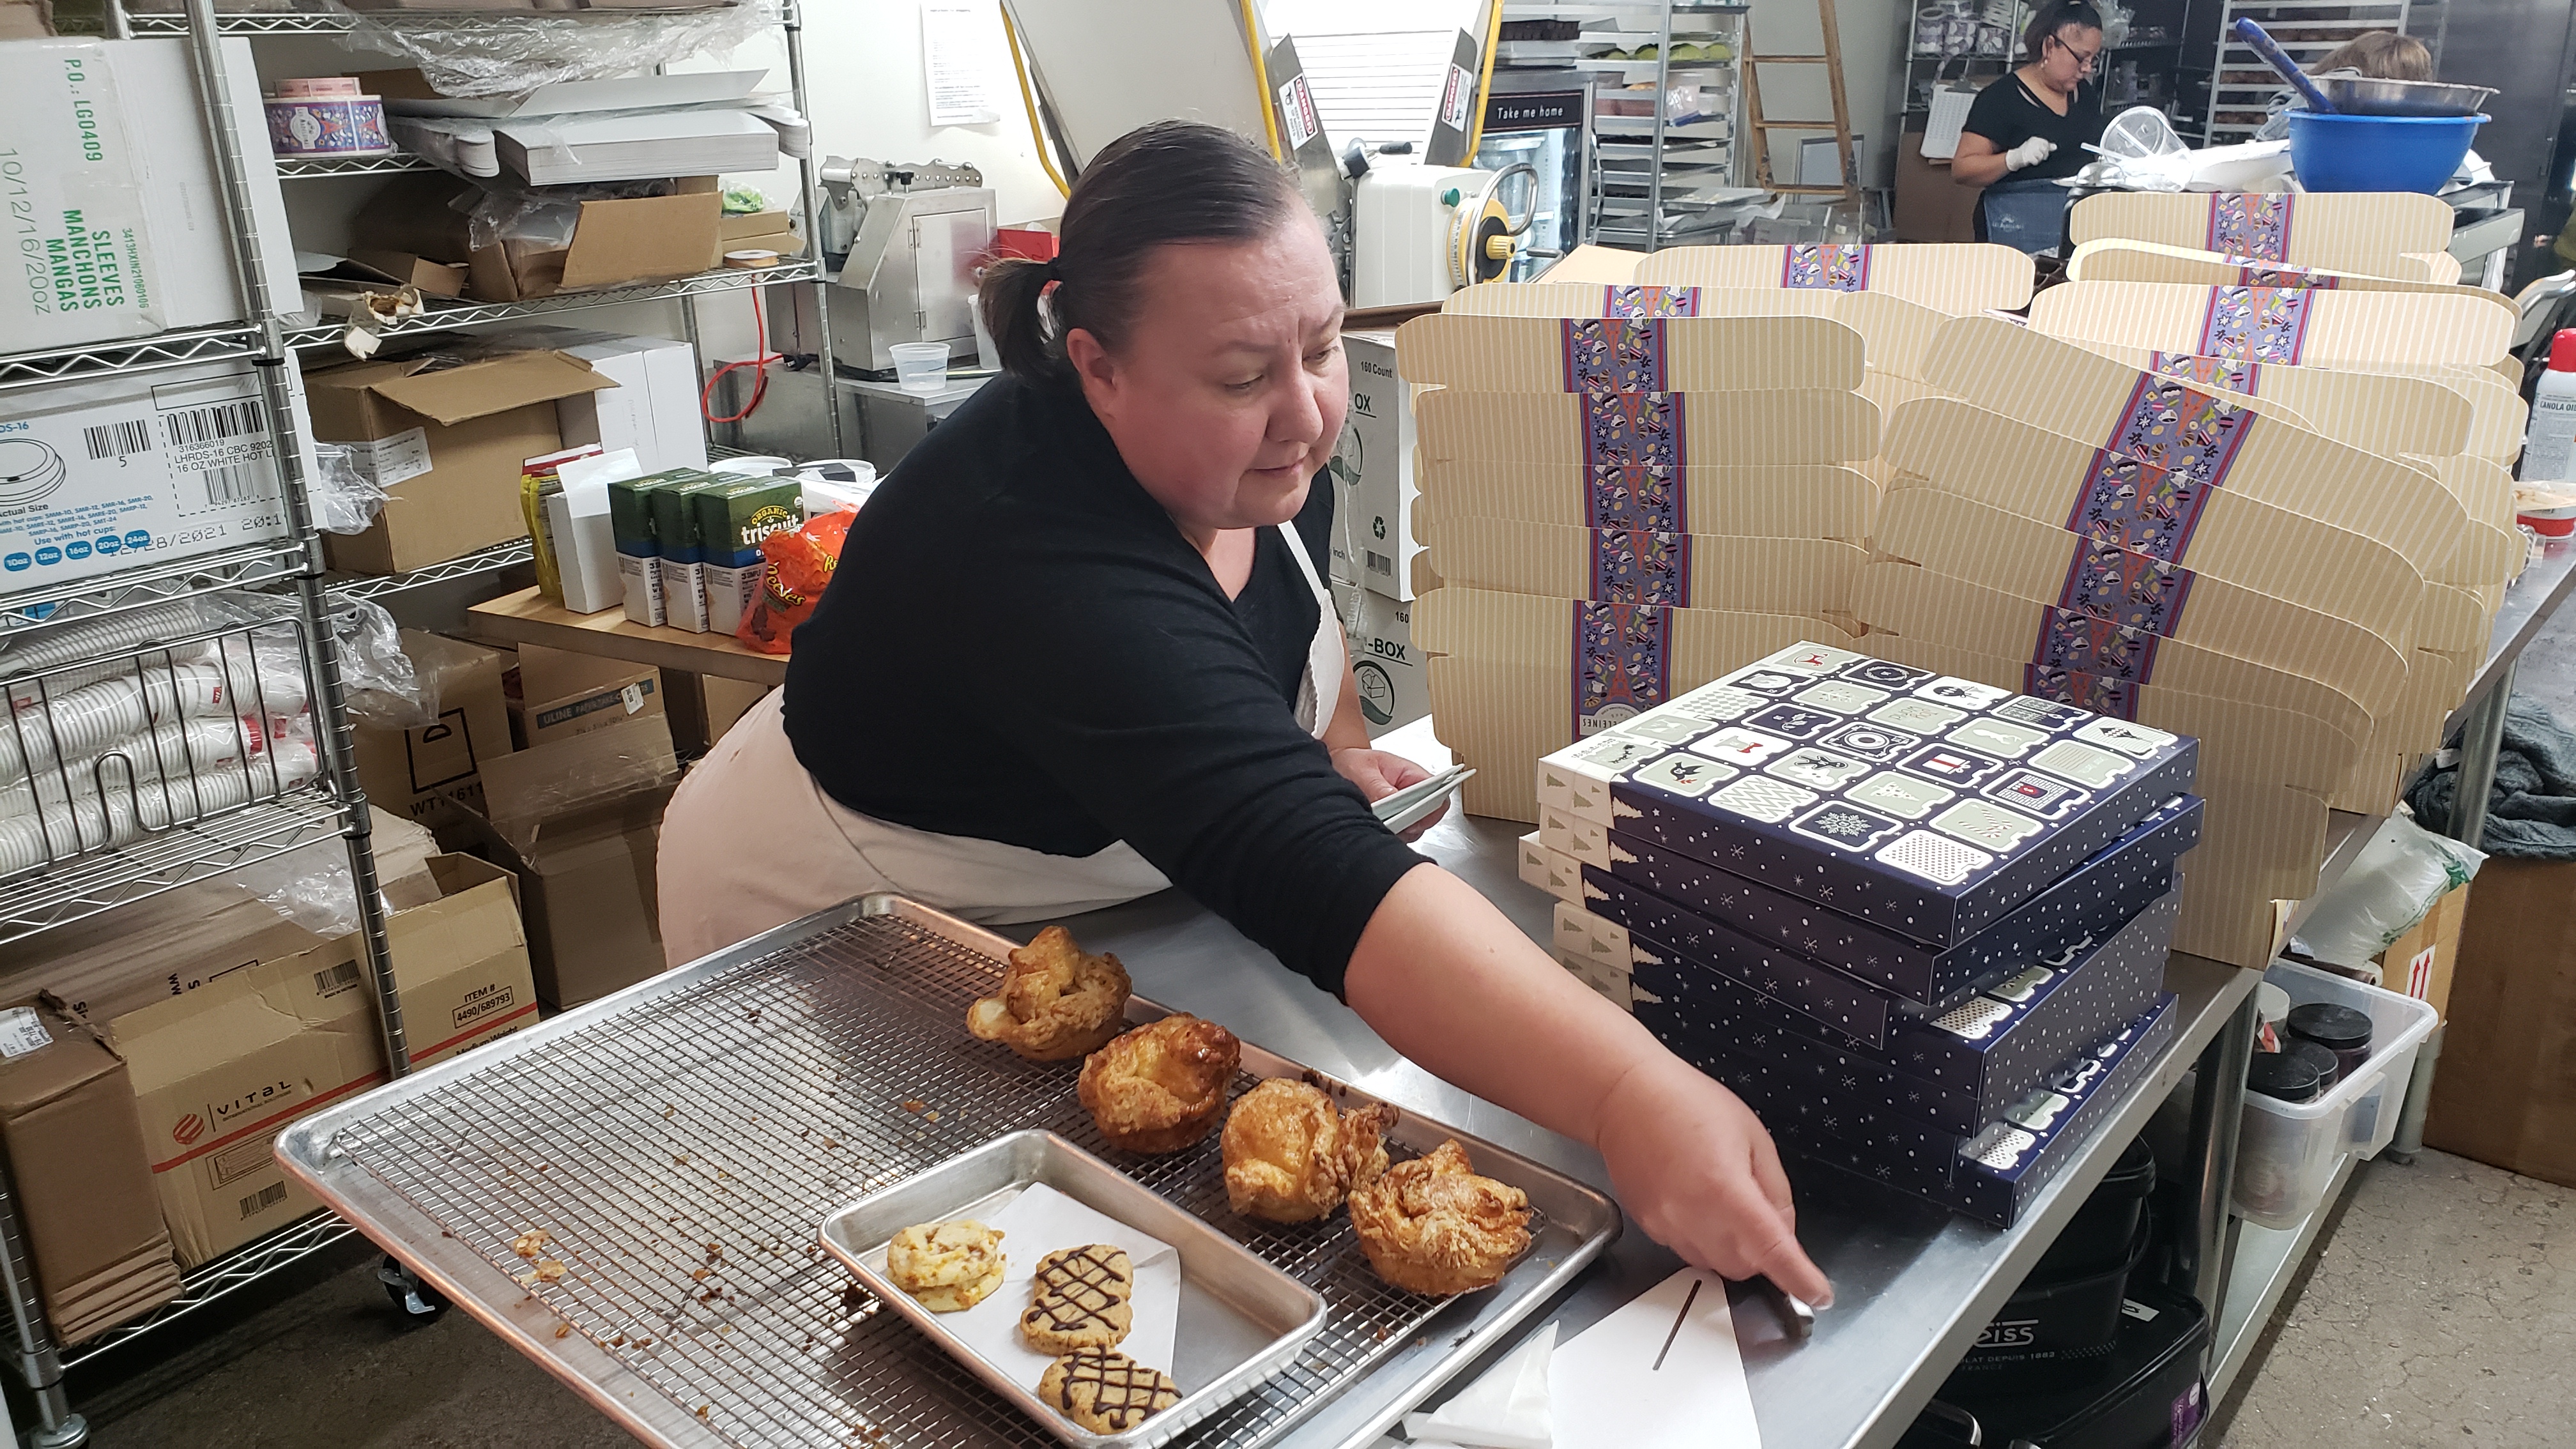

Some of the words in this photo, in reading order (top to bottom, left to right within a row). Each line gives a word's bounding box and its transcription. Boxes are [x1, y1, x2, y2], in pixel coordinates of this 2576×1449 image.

[1446, 73, 1457, 117] DANGER
[1297, 84, 1313, 131] DANGER
[1498, 106, 1519, 119] Take
[1523, 109, 1536, 118] me
[1539, 105, 1563, 117] home
[73, 100, 103, 161] LG0409
[63, 210, 102, 309] MANCHONS
[92, 230, 125, 306] SLEEVES
[45, 239, 79, 312] MANGAS
[1361, 361, 1372, 373] 160
[1372, 364, 1393, 378] Count
[1354, 393, 1371, 413] OX
[2540, 401, 2564, 411] CANOLA
[174, 448, 224, 464] LHRDS-16
[226, 444, 249, 455] CBC
[179, 439, 225, 453] 316366019
[119, 456, 127, 468] 5
[177, 464, 188, 473] 16
[191, 462, 206, 471] OZ
[208, 455, 241, 468] WHITE
[243, 450, 263, 462] HOT
[28, 503, 49, 512] Size
[751, 506, 789, 525] ORGANIC
[54, 533, 73, 541] with
[76, 529, 91, 537] hot
[93, 526, 116, 535] cups:
[6, 558, 28, 567] 10oz
[38, 552, 59, 561] 12oz
[68, 546, 89, 555] 16oz
[98, 540, 119, 549] 20oz
[126, 534, 148, 543] 24oz
[1332, 547, 1346, 560] inch
[1395, 611, 1409, 624] 160
[1368, 638, 1406, 661] -BOX
[543, 708, 572, 724] ULINE
[1583, 718, 1616, 728] ELEINES
[464, 987, 487, 1002] ITEM
[457, 993, 510, 1021] 4490/689793
[217, 1081, 291, 1115] VITAL
